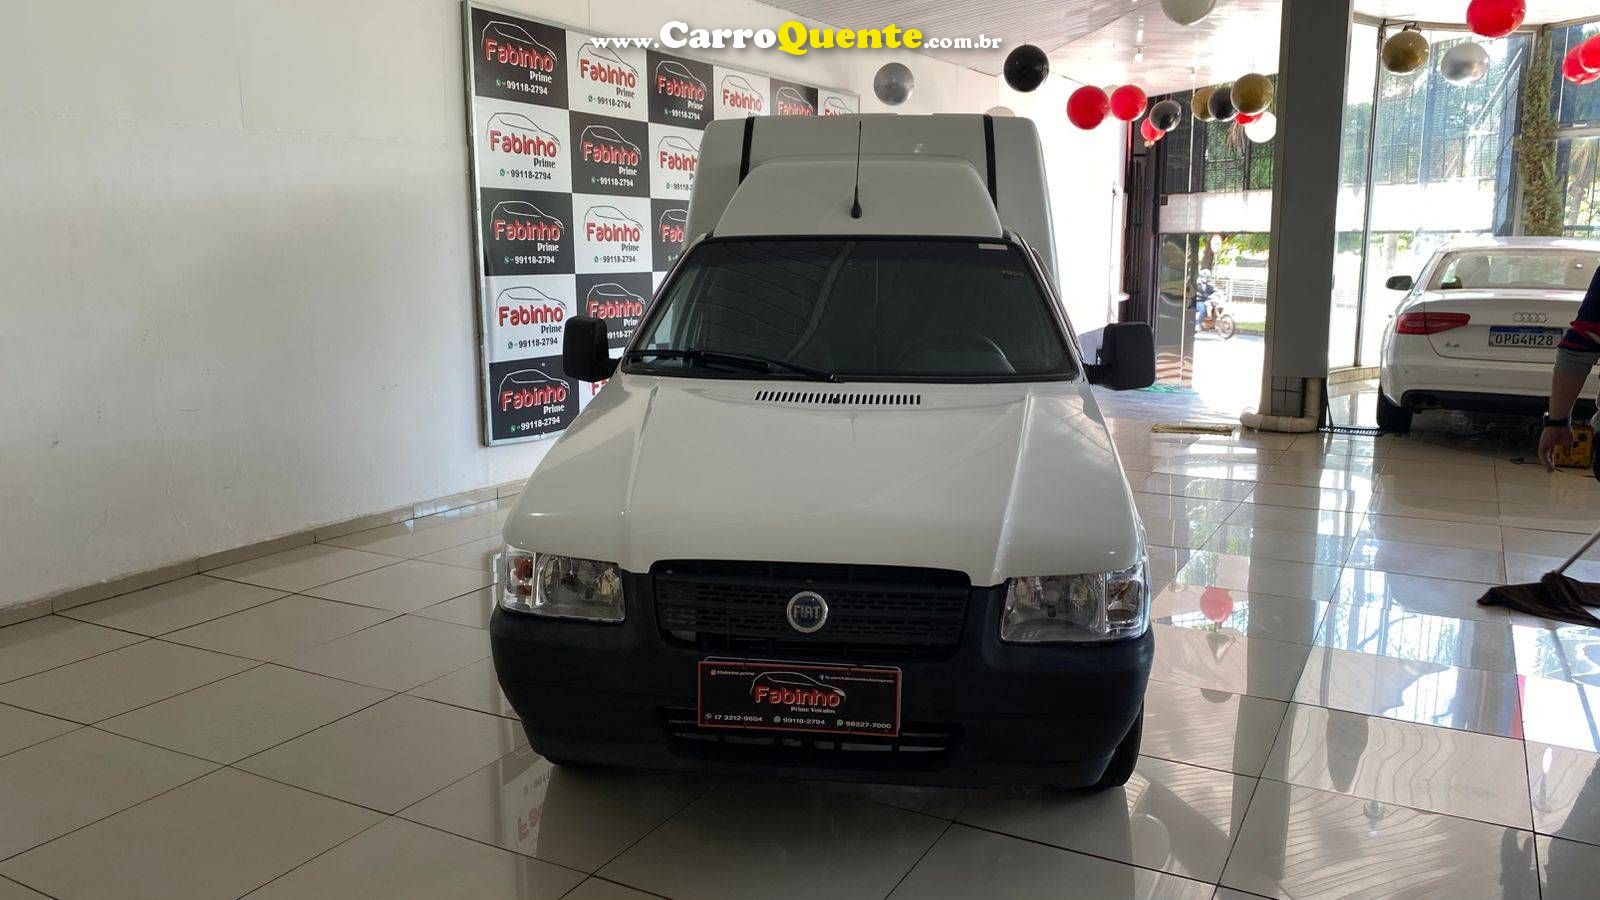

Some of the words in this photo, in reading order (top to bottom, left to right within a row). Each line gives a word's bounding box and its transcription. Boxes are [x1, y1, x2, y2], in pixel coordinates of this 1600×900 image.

[484, 38, 554, 72] Fabinho
[529, 71, 552, 83] Prime
[580, 59, 636, 88] Fabinho
[506, 80, 548, 95] 99118-2794
[616, 87, 635, 98] Prime
[657, 74, 705, 101] Fabinho
[722, 88, 762, 111] Fabinho
[489, 130, 557, 157] Fabinho
[582, 141, 639, 166] Fabinho
[659, 150, 698, 171] Fabinh
[533, 157, 556, 168] Prime
[510, 169, 551, 180] 99118-2794
[618, 166, 637, 176] Prime
[493, 218, 560, 242] Fabinho
[586, 221, 640, 242] Fabinho
[537, 242, 559, 252] Prime
[621, 243, 639, 252] Prime
[514, 255, 555, 264] 99118-2794
[499, 304, 563, 326] Fabinho
[588, 299, 643, 319] Fabinho
[541, 325, 562, 334] Prime
[518, 337, 558, 348] 99118-2794
[1494, 334, 1554, 347] OPG4H28
[502, 385, 567, 412] Fabinho
[543, 403, 565, 415] Prime
[520, 416, 560, 431] 99118-2794
[793, 604, 821, 619] FIAT
[755, 686, 841, 707] Fabinho
[790, 705, 810, 713] Prime
